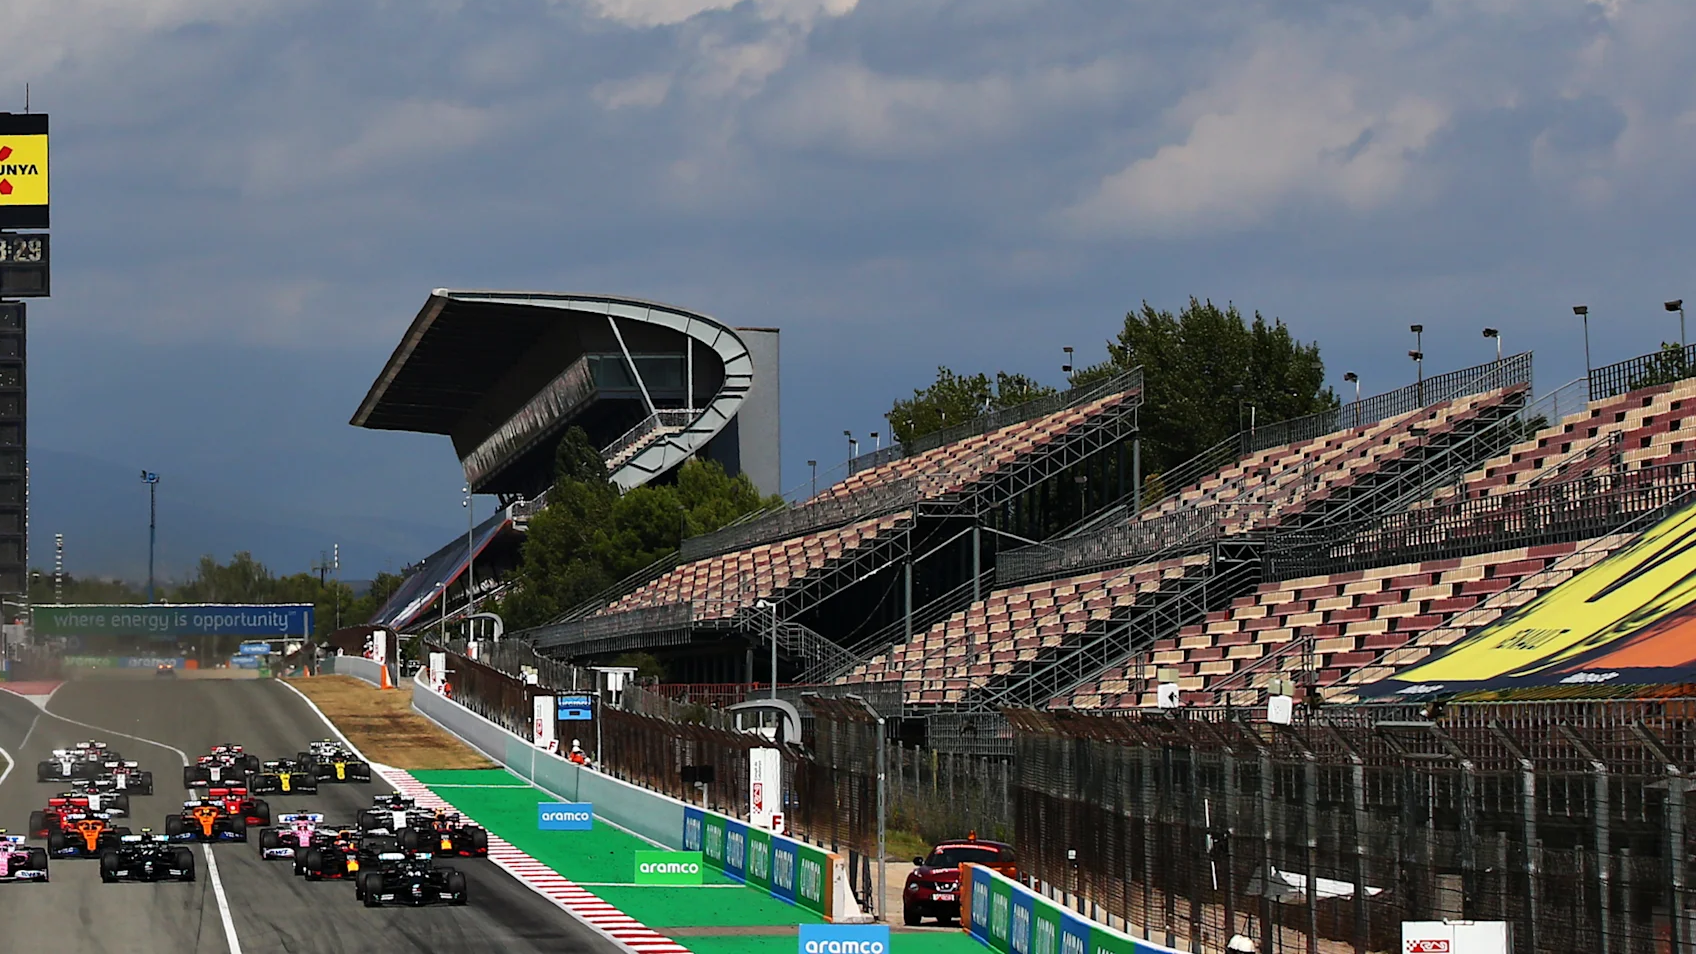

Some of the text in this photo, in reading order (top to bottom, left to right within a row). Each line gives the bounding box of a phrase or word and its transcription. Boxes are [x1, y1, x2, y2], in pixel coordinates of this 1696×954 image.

[54, 612, 288, 631] where energy is opportunity
[548, 741, 556, 750] F
[541, 811, 589, 821] aramco
[772, 815, 782, 830] F
[639, 862, 698, 874] aramco
[805, 940, 884, 954] aramco
